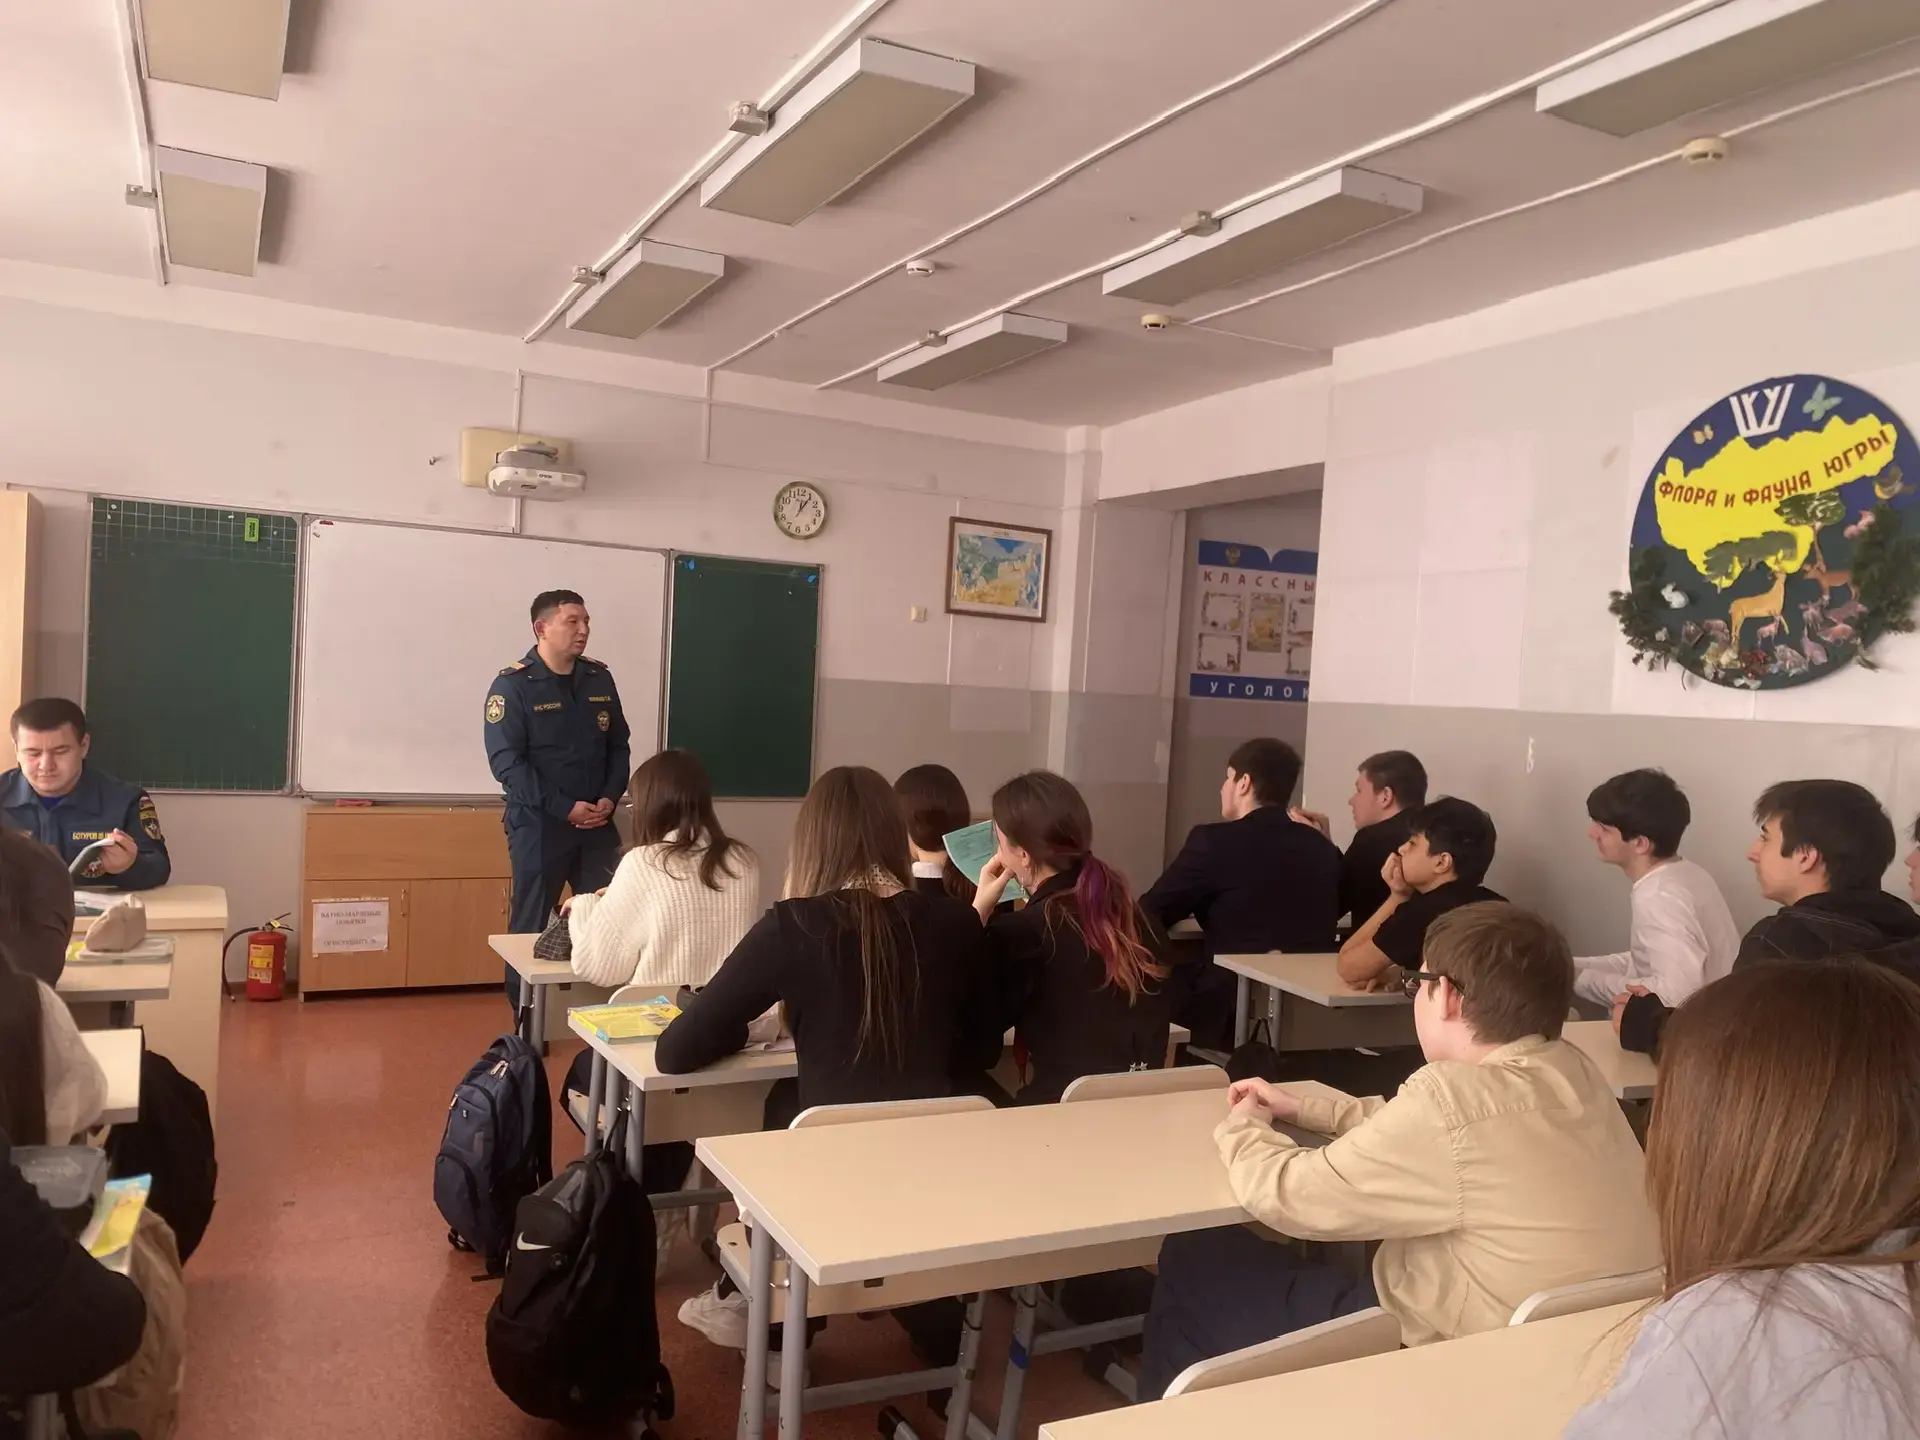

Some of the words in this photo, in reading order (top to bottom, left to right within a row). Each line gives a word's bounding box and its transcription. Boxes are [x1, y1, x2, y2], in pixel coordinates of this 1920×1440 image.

[1658, 480, 1718, 507] ФЛОРА
[1742, 470, 1813, 506] ФАУНА
[1823, 429, 1891, 478] ЮГРЫ
